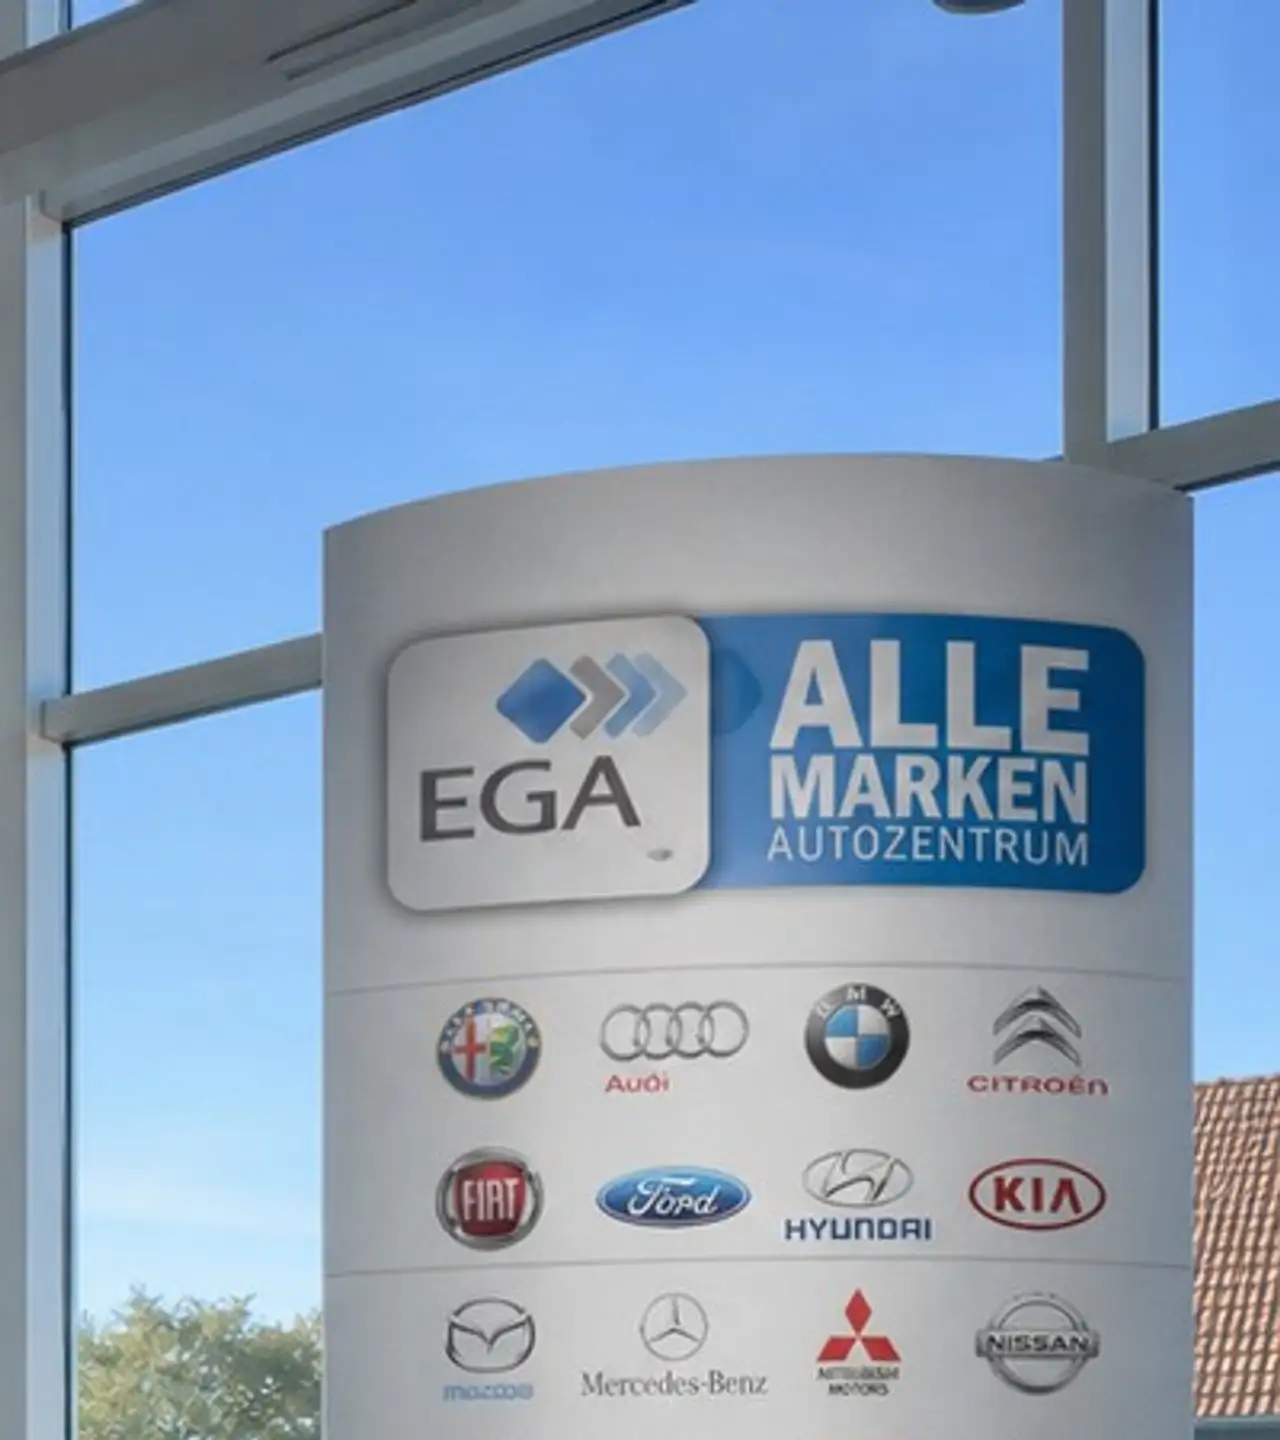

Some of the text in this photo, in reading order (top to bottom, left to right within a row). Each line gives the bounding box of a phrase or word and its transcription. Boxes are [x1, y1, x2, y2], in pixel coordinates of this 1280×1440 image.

[768, 638, 1090, 756] ALLE
[419, 755, 641, 843] EGA
[768, 754, 1088, 825] MARKEN
[767, 824, 1089, 867] AUTOZENTRUM
[604, 1073, 670, 1093] Audi
[461, 1177, 520, 1221] FIAT
[626, 1176, 720, 1217] Ford
[993, 1177, 1083, 1214] KIA
[784, 1217, 932, 1241] HYUNDAI
[987, 1333, 1090, 1352] NISSAN
[579, 1369, 768, 1398] Mercedes-Benz
